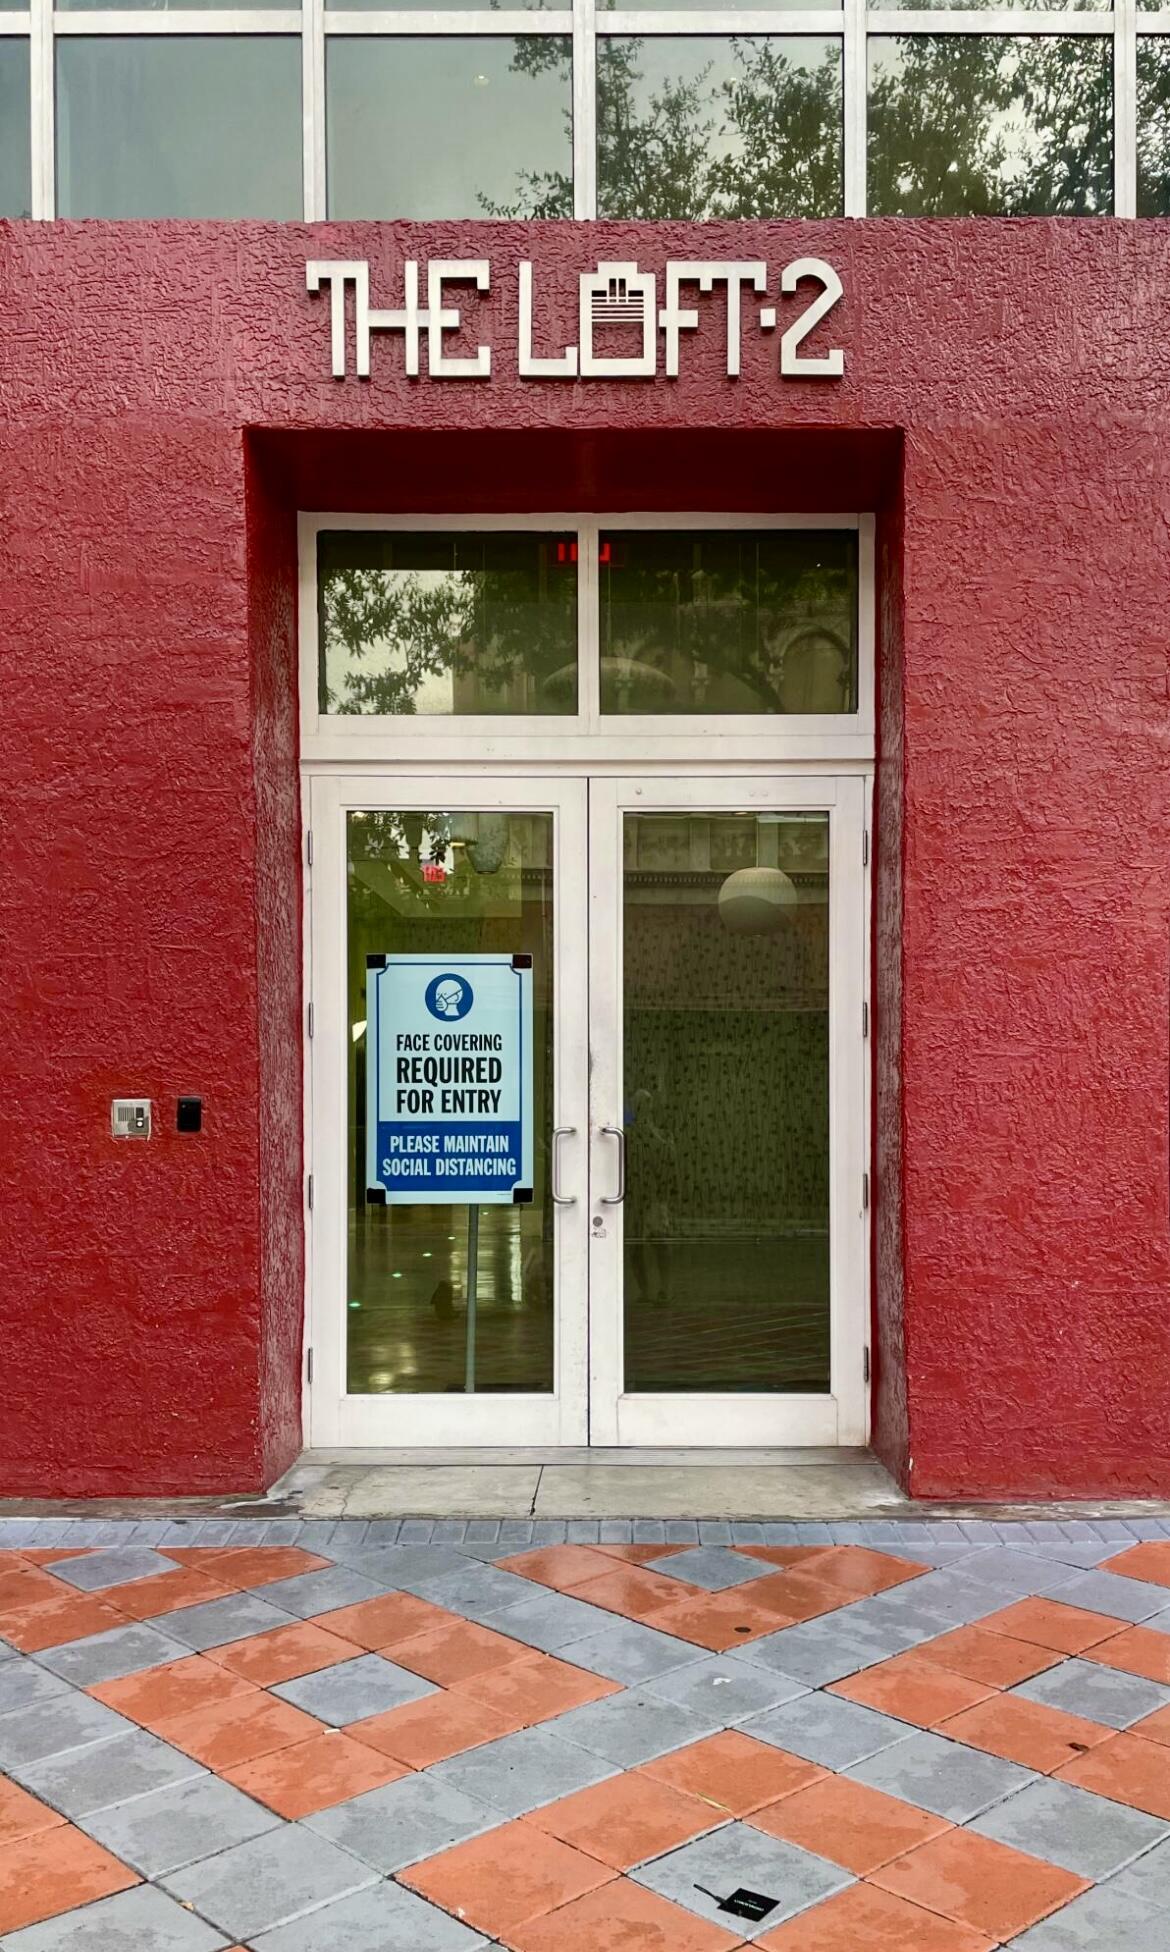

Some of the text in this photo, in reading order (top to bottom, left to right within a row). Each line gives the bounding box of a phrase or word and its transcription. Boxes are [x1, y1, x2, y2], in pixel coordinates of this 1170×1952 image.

[306, 260, 490, 377] THE
[396, 1034, 502, 1051] FACE COVERING
[396, 1057, 502, 1087] REQUIRED
[396, 1089, 502, 1114] FOR ENTRY
[390, 1135, 509, 1153] PLEASE MAINTAIN
[382, 1158, 516, 1176] SOCIAL DISTANCING
